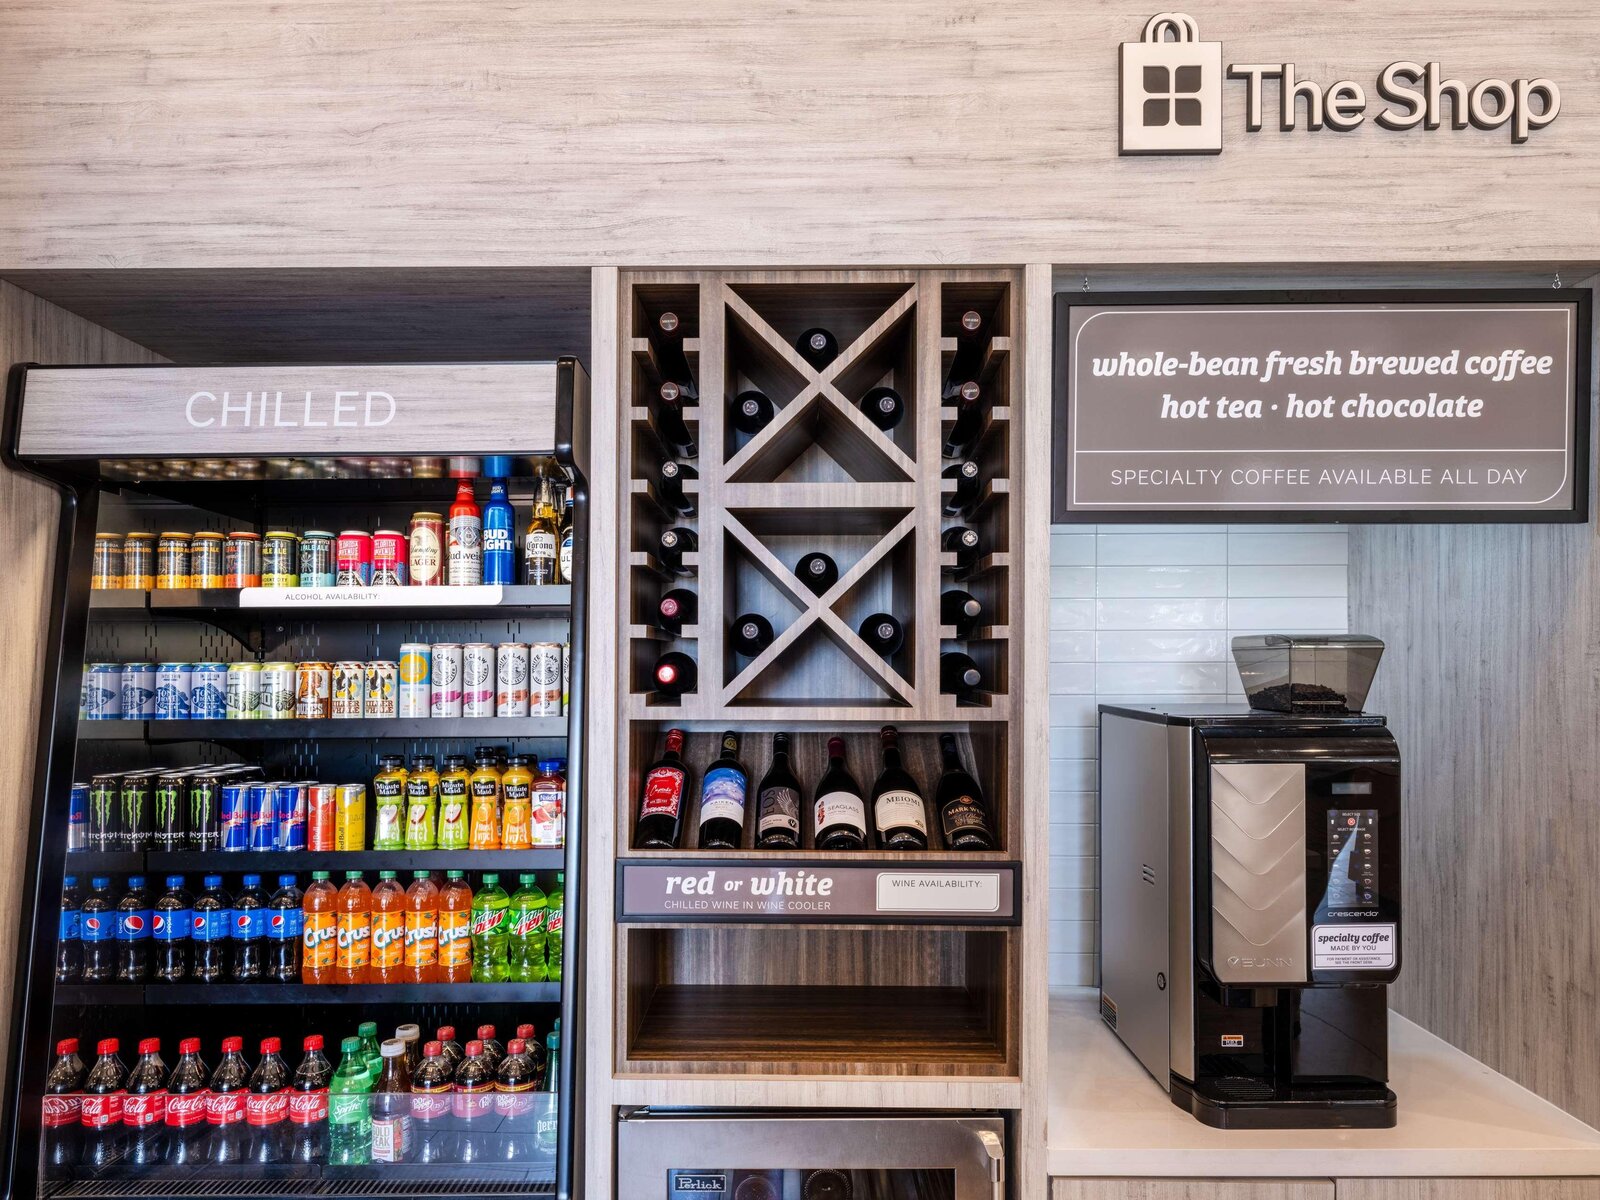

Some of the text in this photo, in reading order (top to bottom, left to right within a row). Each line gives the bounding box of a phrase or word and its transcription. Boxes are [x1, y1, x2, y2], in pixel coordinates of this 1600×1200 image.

[1227, 60, 1561, 144] The Shop
[1092, 350, 1553, 382] whole-bean fresh brewed coffee
[185, 391, 396, 428] CHILLED
[1160, 394, 1484, 419] hot tea hot chocolate
[1111, 468, 1527, 486] SPECIALTY COFFEE AVAILABLE ALL DAY
[483, 529, 508, 540] BUD
[483, 540, 512, 551] IGHT
[526, 541, 553, 551] Corona
[285, 593, 323, 601] ALCOHOL
[827, 804, 860, 814] SEAGLASS
[665, 870, 833, 896] red or white
[919, 880, 982, 888] AVAILABILITY:
[664, 900, 831, 910] CHILLED WINE IN WINE COOLER
[304, 926, 337, 947] Crus
[338, 926, 370, 947] Crus
[373, 926, 404, 948] Crus
[1318, 932, 1390, 944] specialty coffee
[1241, 958, 1293, 968] BUNN
[335, 1102, 361, 1115] Sprite
[536, 1119, 557, 1139] perr
[678, 1177, 722, 1189] Perlick
